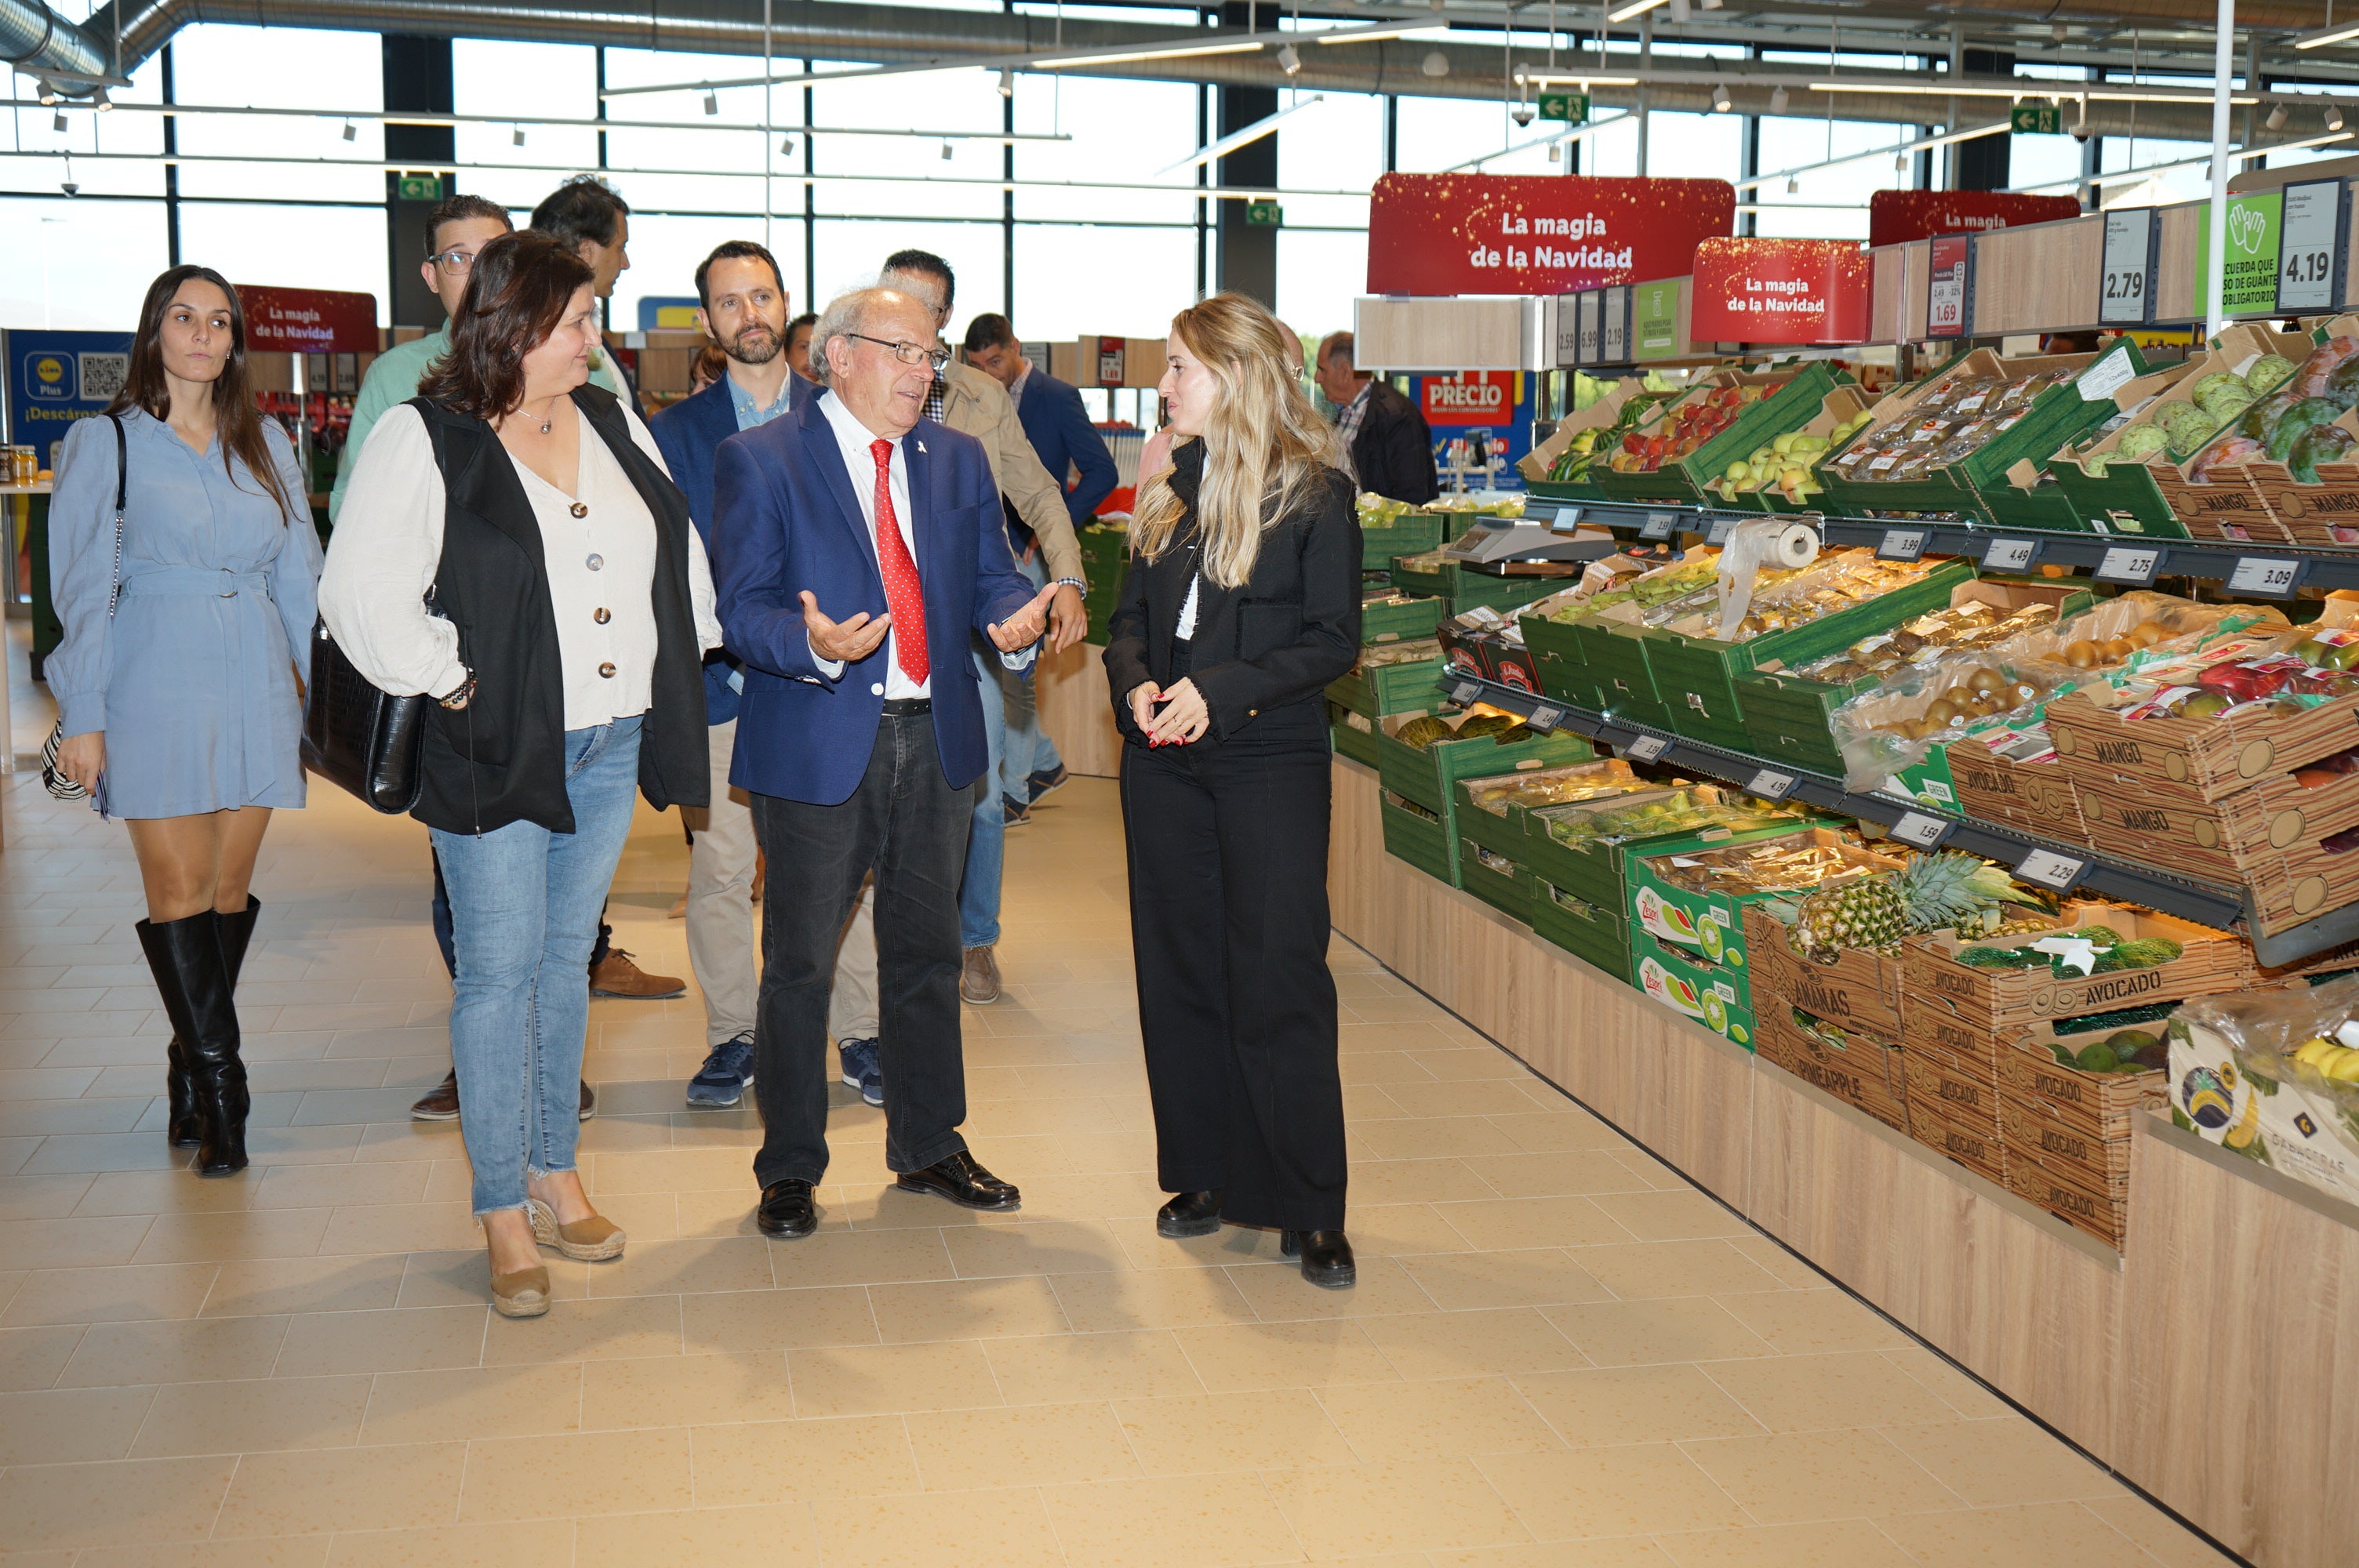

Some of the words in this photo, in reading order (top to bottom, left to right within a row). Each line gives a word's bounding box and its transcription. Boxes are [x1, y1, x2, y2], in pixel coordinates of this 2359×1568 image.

[1502, 212, 1528, 234] La
[1534, 212, 1606, 240] magia
[1946, 212, 1961, 227] La
[1964, 213, 2006, 230] magia
[1470, 245, 1501, 267] de
[1507, 245, 1528, 267] la
[1534, 245, 1633, 268] Navidad
[2223, 260, 2255, 274] CUERDA
[2257, 259, 2274, 273] QUE
[2286, 252, 2328, 282] 4.19
[1746, 278, 1762, 292] La
[1765, 278, 1808, 295] magia
[2106, 272, 2143, 298] 2.79
[2223, 278, 2234, 290] SO
[2235, 277, 2245, 289] DE
[2246, 274, 2277, 289] GUANTE
[1728, 297, 1747, 310] de
[1749, 297, 1762, 311] la
[1765, 298, 1825, 312] Navidad
[2223, 289, 2276, 306] OBLIGATORIO
[270, 307, 282, 320] La
[285, 308, 321, 323] magia
[1936, 303, 1957, 322] 1.69
[256, 324, 271, 336] de
[276, 324, 284, 337] la
[286, 325, 334, 340] Navidad
[1581, 331, 1598, 348] 6.99
[1607, 328, 1622, 345] 2.19
[1559, 333, 1574, 350] 2.59
[40, 385, 62, 396] Plus
[1429, 384, 1503, 406] PRECIO
[2202, 492, 2250, 511] MANGO
[1901, 539, 1919, 551] 3.99
[2009, 549, 2029, 562] 4.49
[2128, 558, 2152, 573] 2.75
[2263, 570, 2292, 585] 3.09
[2092, 741, 2143, 764] MANGO
[1770, 781, 1787, 793] 4.19
[1927, 783, 1949, 799] GREEN
[1966, 769, 2016, 795] AVOCADO
[2119, 808, 2171, 831] MANGO
[1919, 824, 1939, 839] 1.59
[2048, 864, 2074, 880] 2.29
[1642, 900, 1659, 923] Zespri
[1713, 909, 1728, 924] GREEN
[1645, 970, 1663, 993] Zespri
[1936, 971, 1975, 996] AVOCADO
[2085, 971, 2161, 1007] AVOCADO
[1717, 985, 1732, 1001] GREEN
[1794, 978, 1851, 1018] ANANAS
[1937, 1023, 1976, 1051] AVOCADO
[1798, 1058, 1863, 1101] PINEAPPLE
[2035, 1073, 2081, 1103] AVOCADO
[1939, 1078, 1979, 1106] AVOCADO
[1946, 1130, 1985, 1160] AVOCADO
[2041, 1129, 2087, 1160] AVOCADO
[2049, 1185, 2095, 1218] AVOCADO
